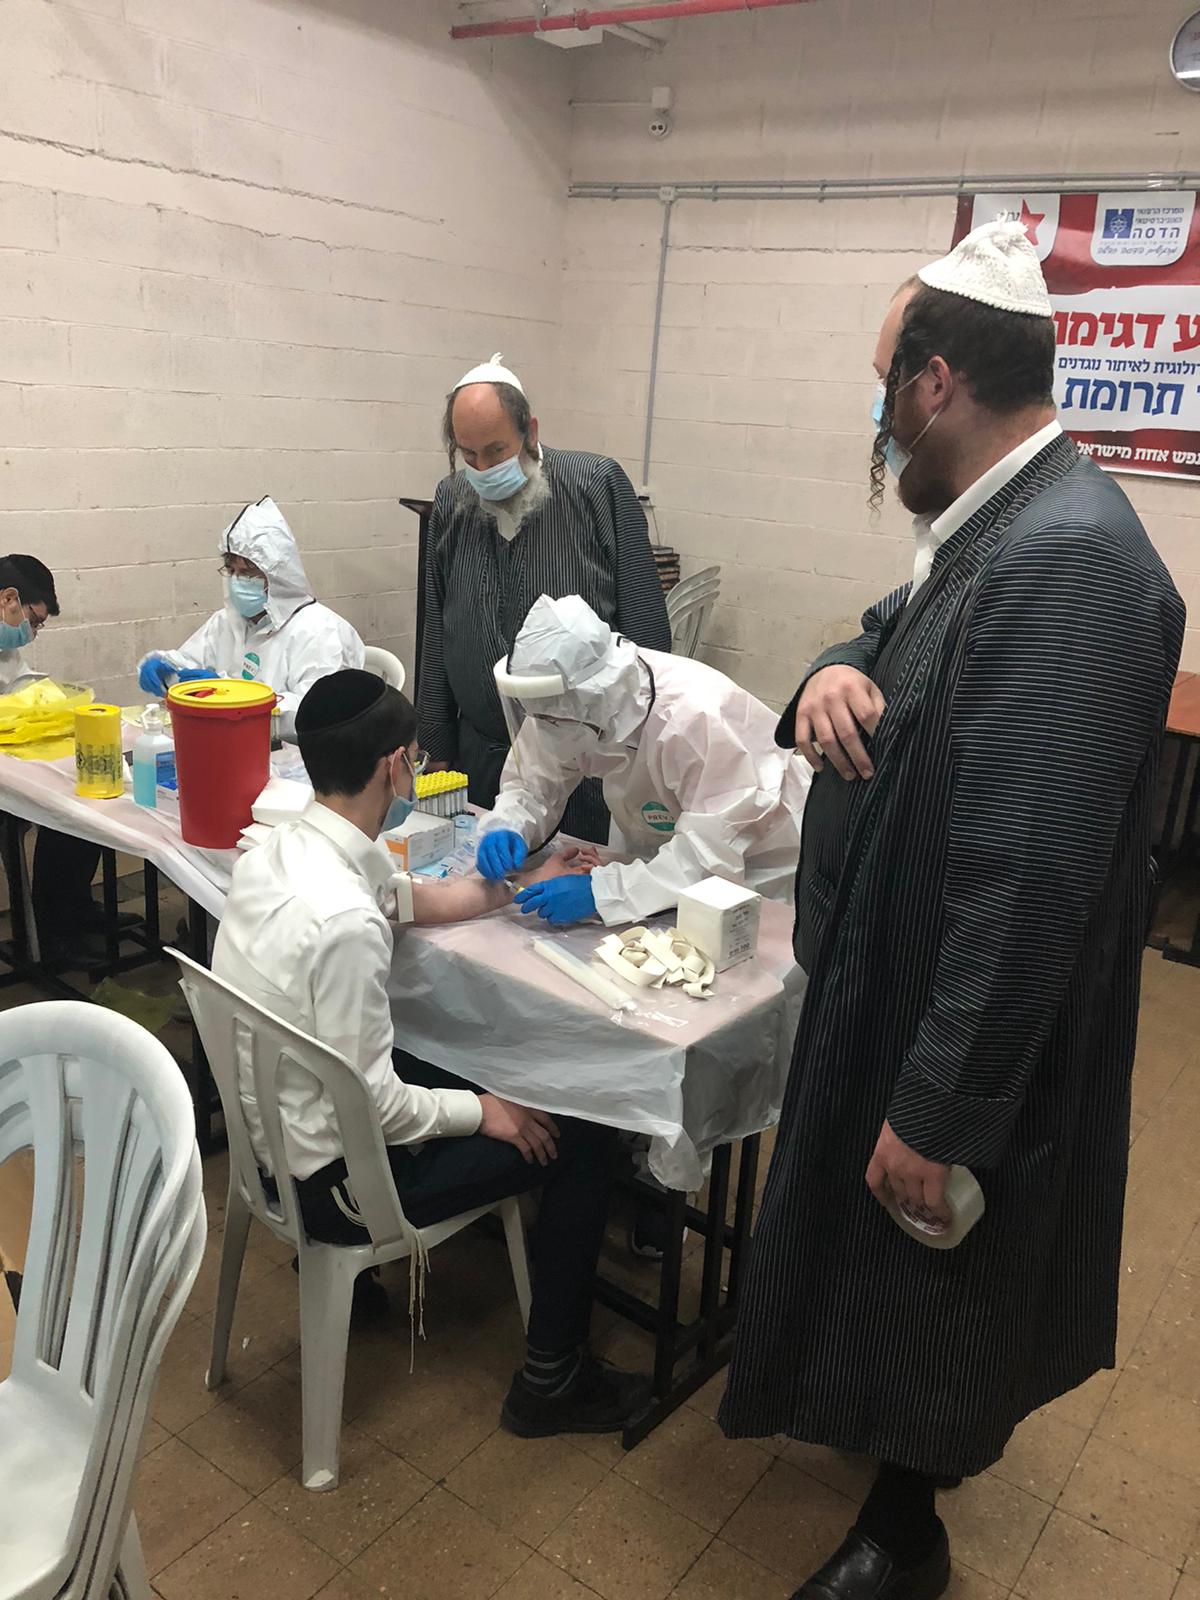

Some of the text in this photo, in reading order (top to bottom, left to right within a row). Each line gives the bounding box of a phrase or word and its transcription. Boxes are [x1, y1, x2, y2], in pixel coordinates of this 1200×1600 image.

[1132, 227, 1180, 239] הדסה
[1053, 311, 1165, 349] דגימו
[1058, 356, 1101, 371] נוגדנים
[1105, 358, 1150, 373] לאיתור
[1061, 377, 1185, 416] תרומת
[1076, 440, 1131, 459] מישראל
[1134, 447, 1169, 462] אחת
